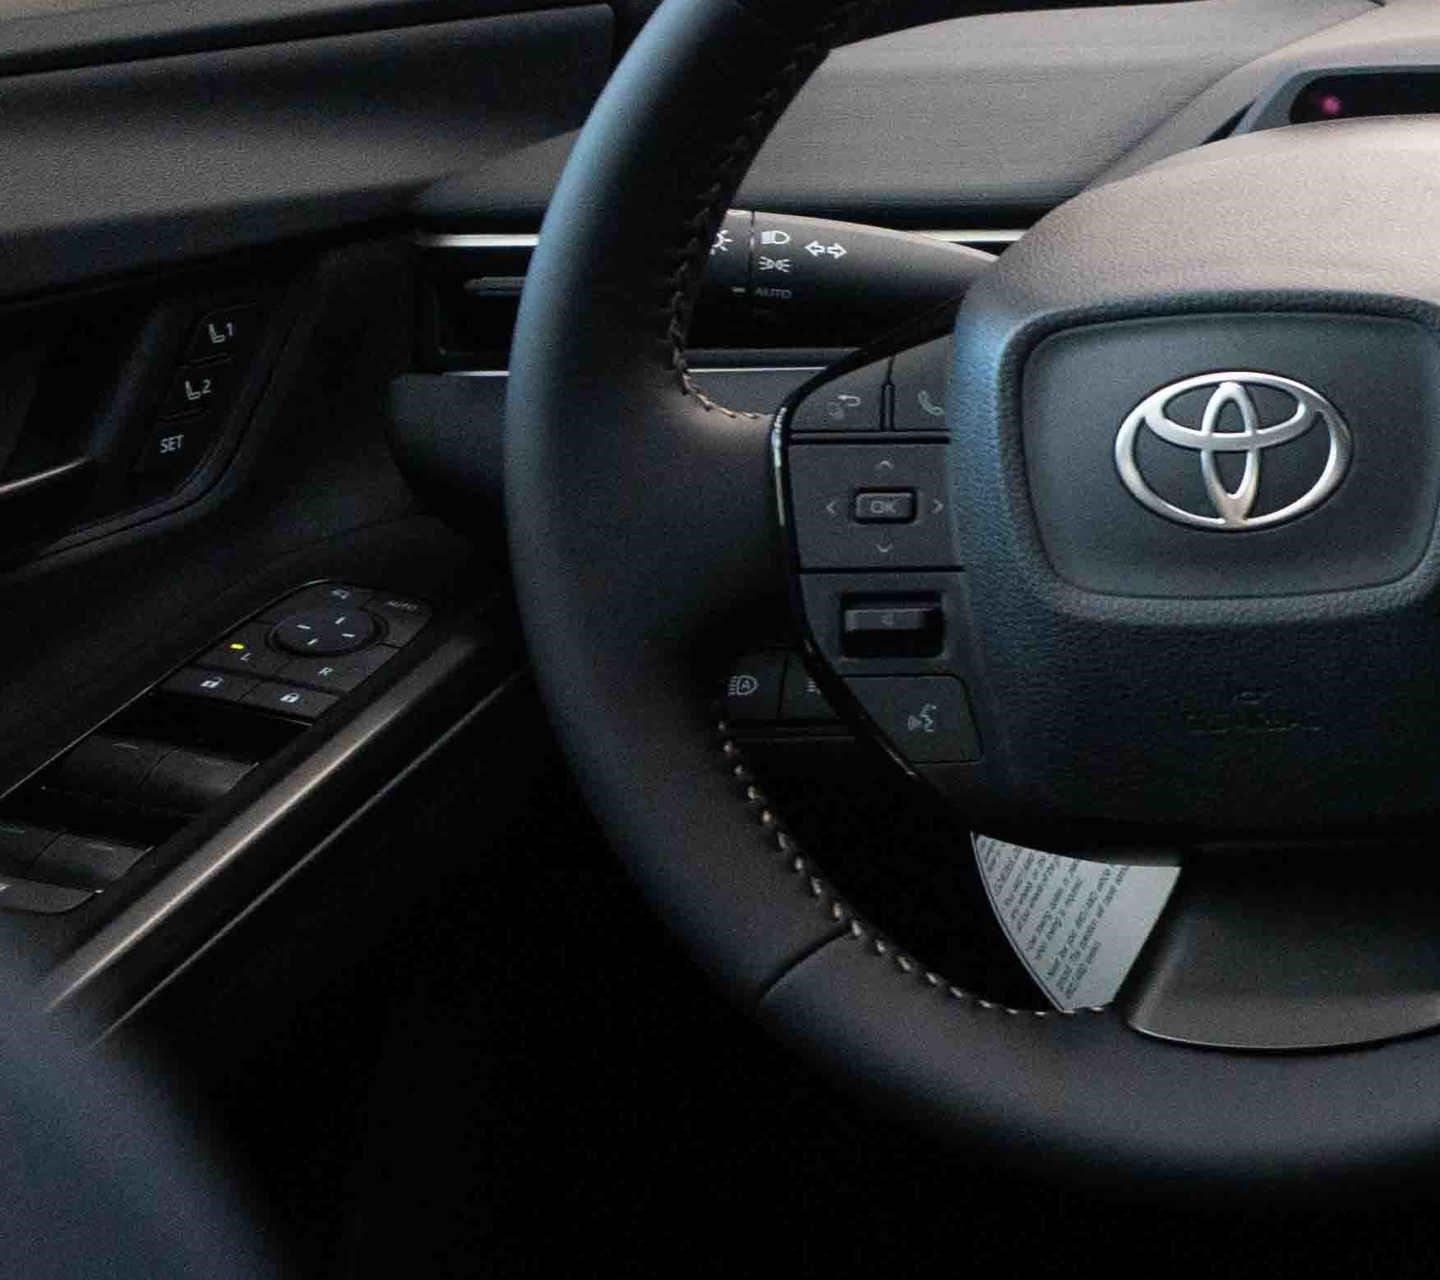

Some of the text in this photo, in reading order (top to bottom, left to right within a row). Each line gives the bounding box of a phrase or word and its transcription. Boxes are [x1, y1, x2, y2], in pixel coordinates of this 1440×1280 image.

[755, 286, 793, 300] AUTO
[225, 322, 234, 337] 1
[201, 379, 212, 394] 2
[159, 434, 185, 454] SET
[870, 500, 897, 514] OK
[240, 651, 252, 663] L
[319, 666, 334, 677] R
